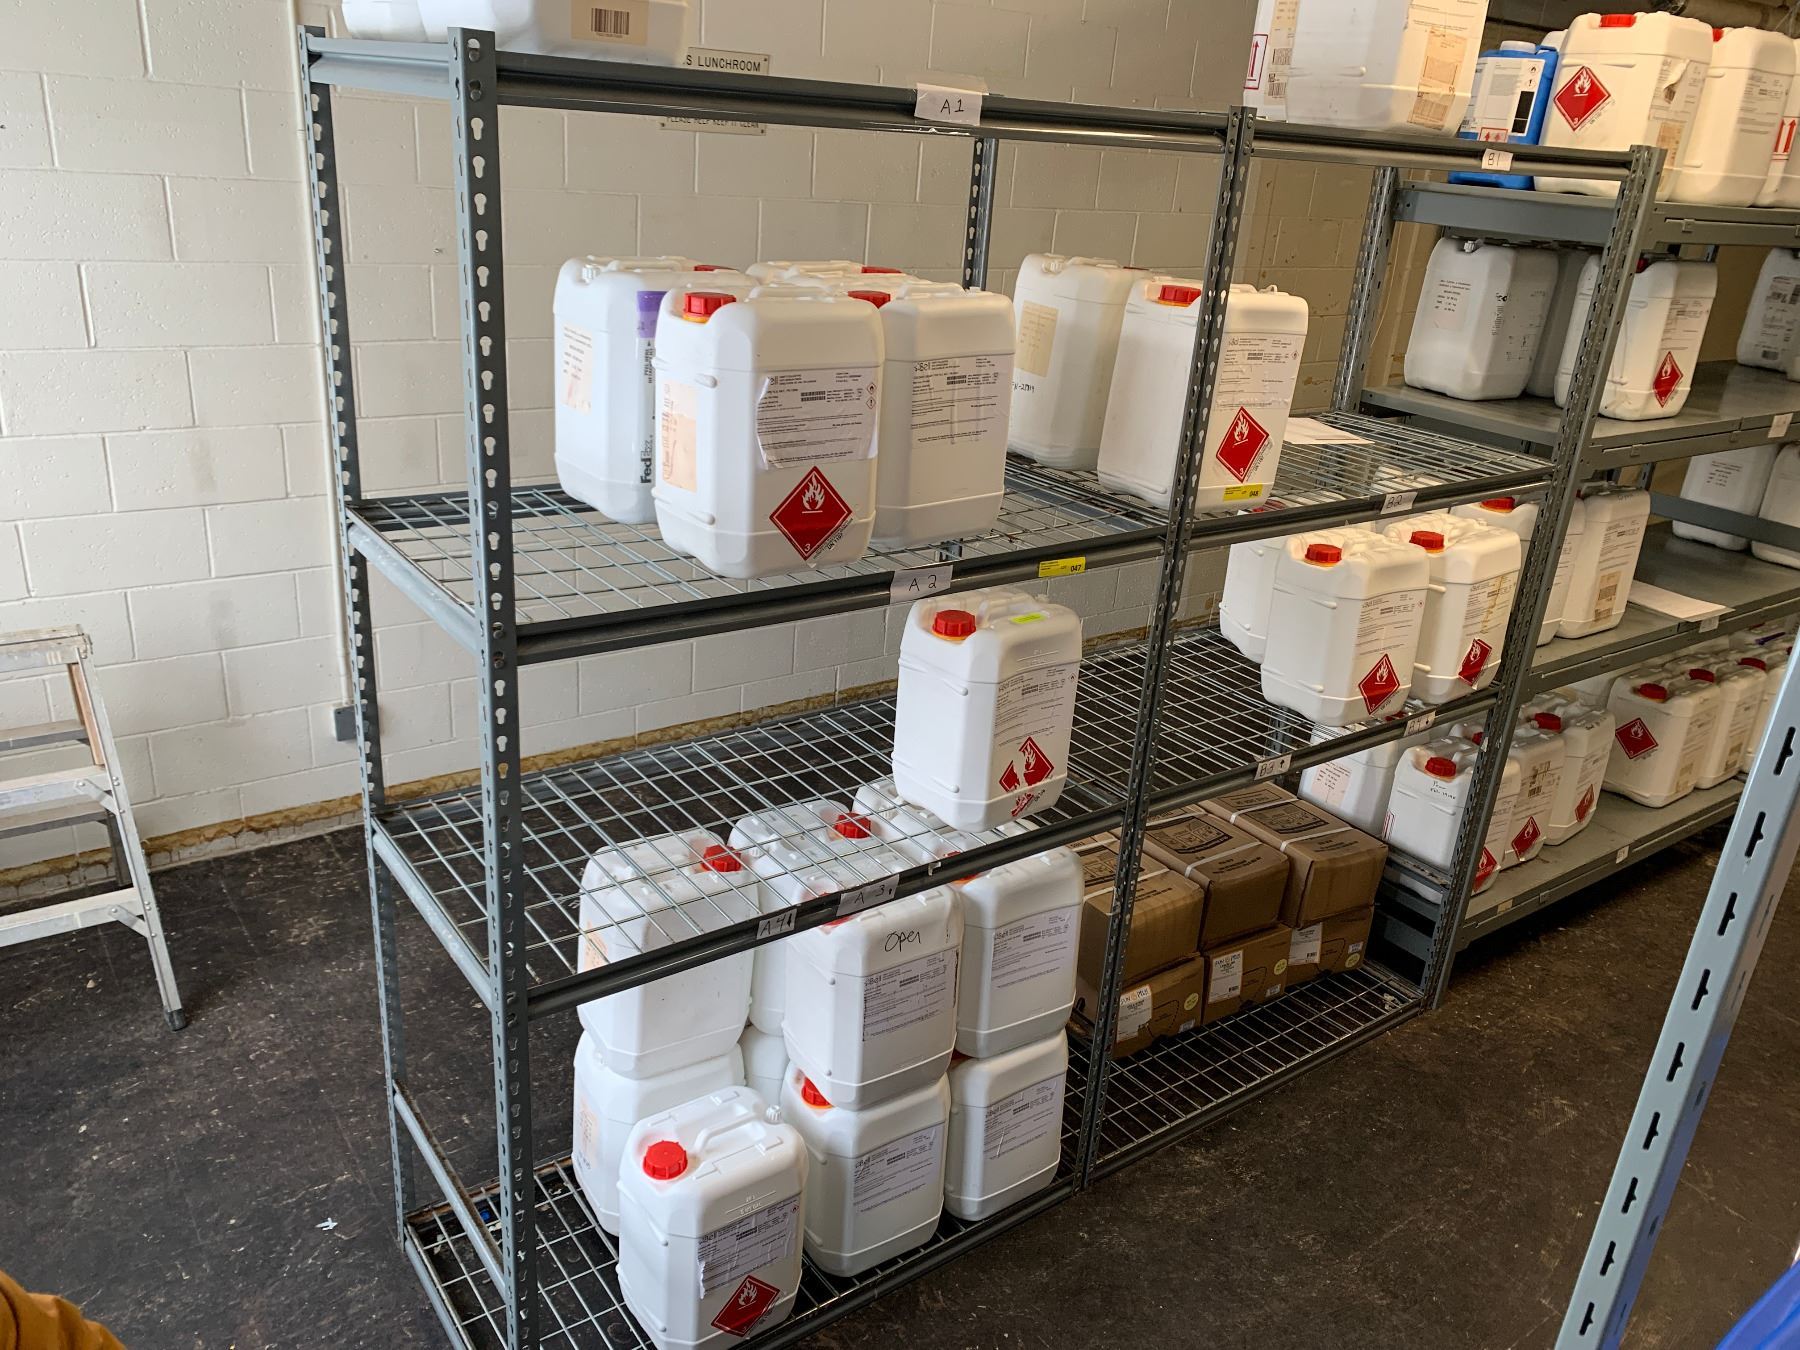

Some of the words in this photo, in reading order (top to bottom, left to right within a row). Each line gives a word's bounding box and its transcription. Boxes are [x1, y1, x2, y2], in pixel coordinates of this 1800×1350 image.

[697, 56, 762, 73] LUNCHROOM
[1239, 467, 1245, 476] 3
[1387, 494, 1403, 510] B2
[804, 543, 811, 552] 3
[1070, 564, 1082, 573] 047
